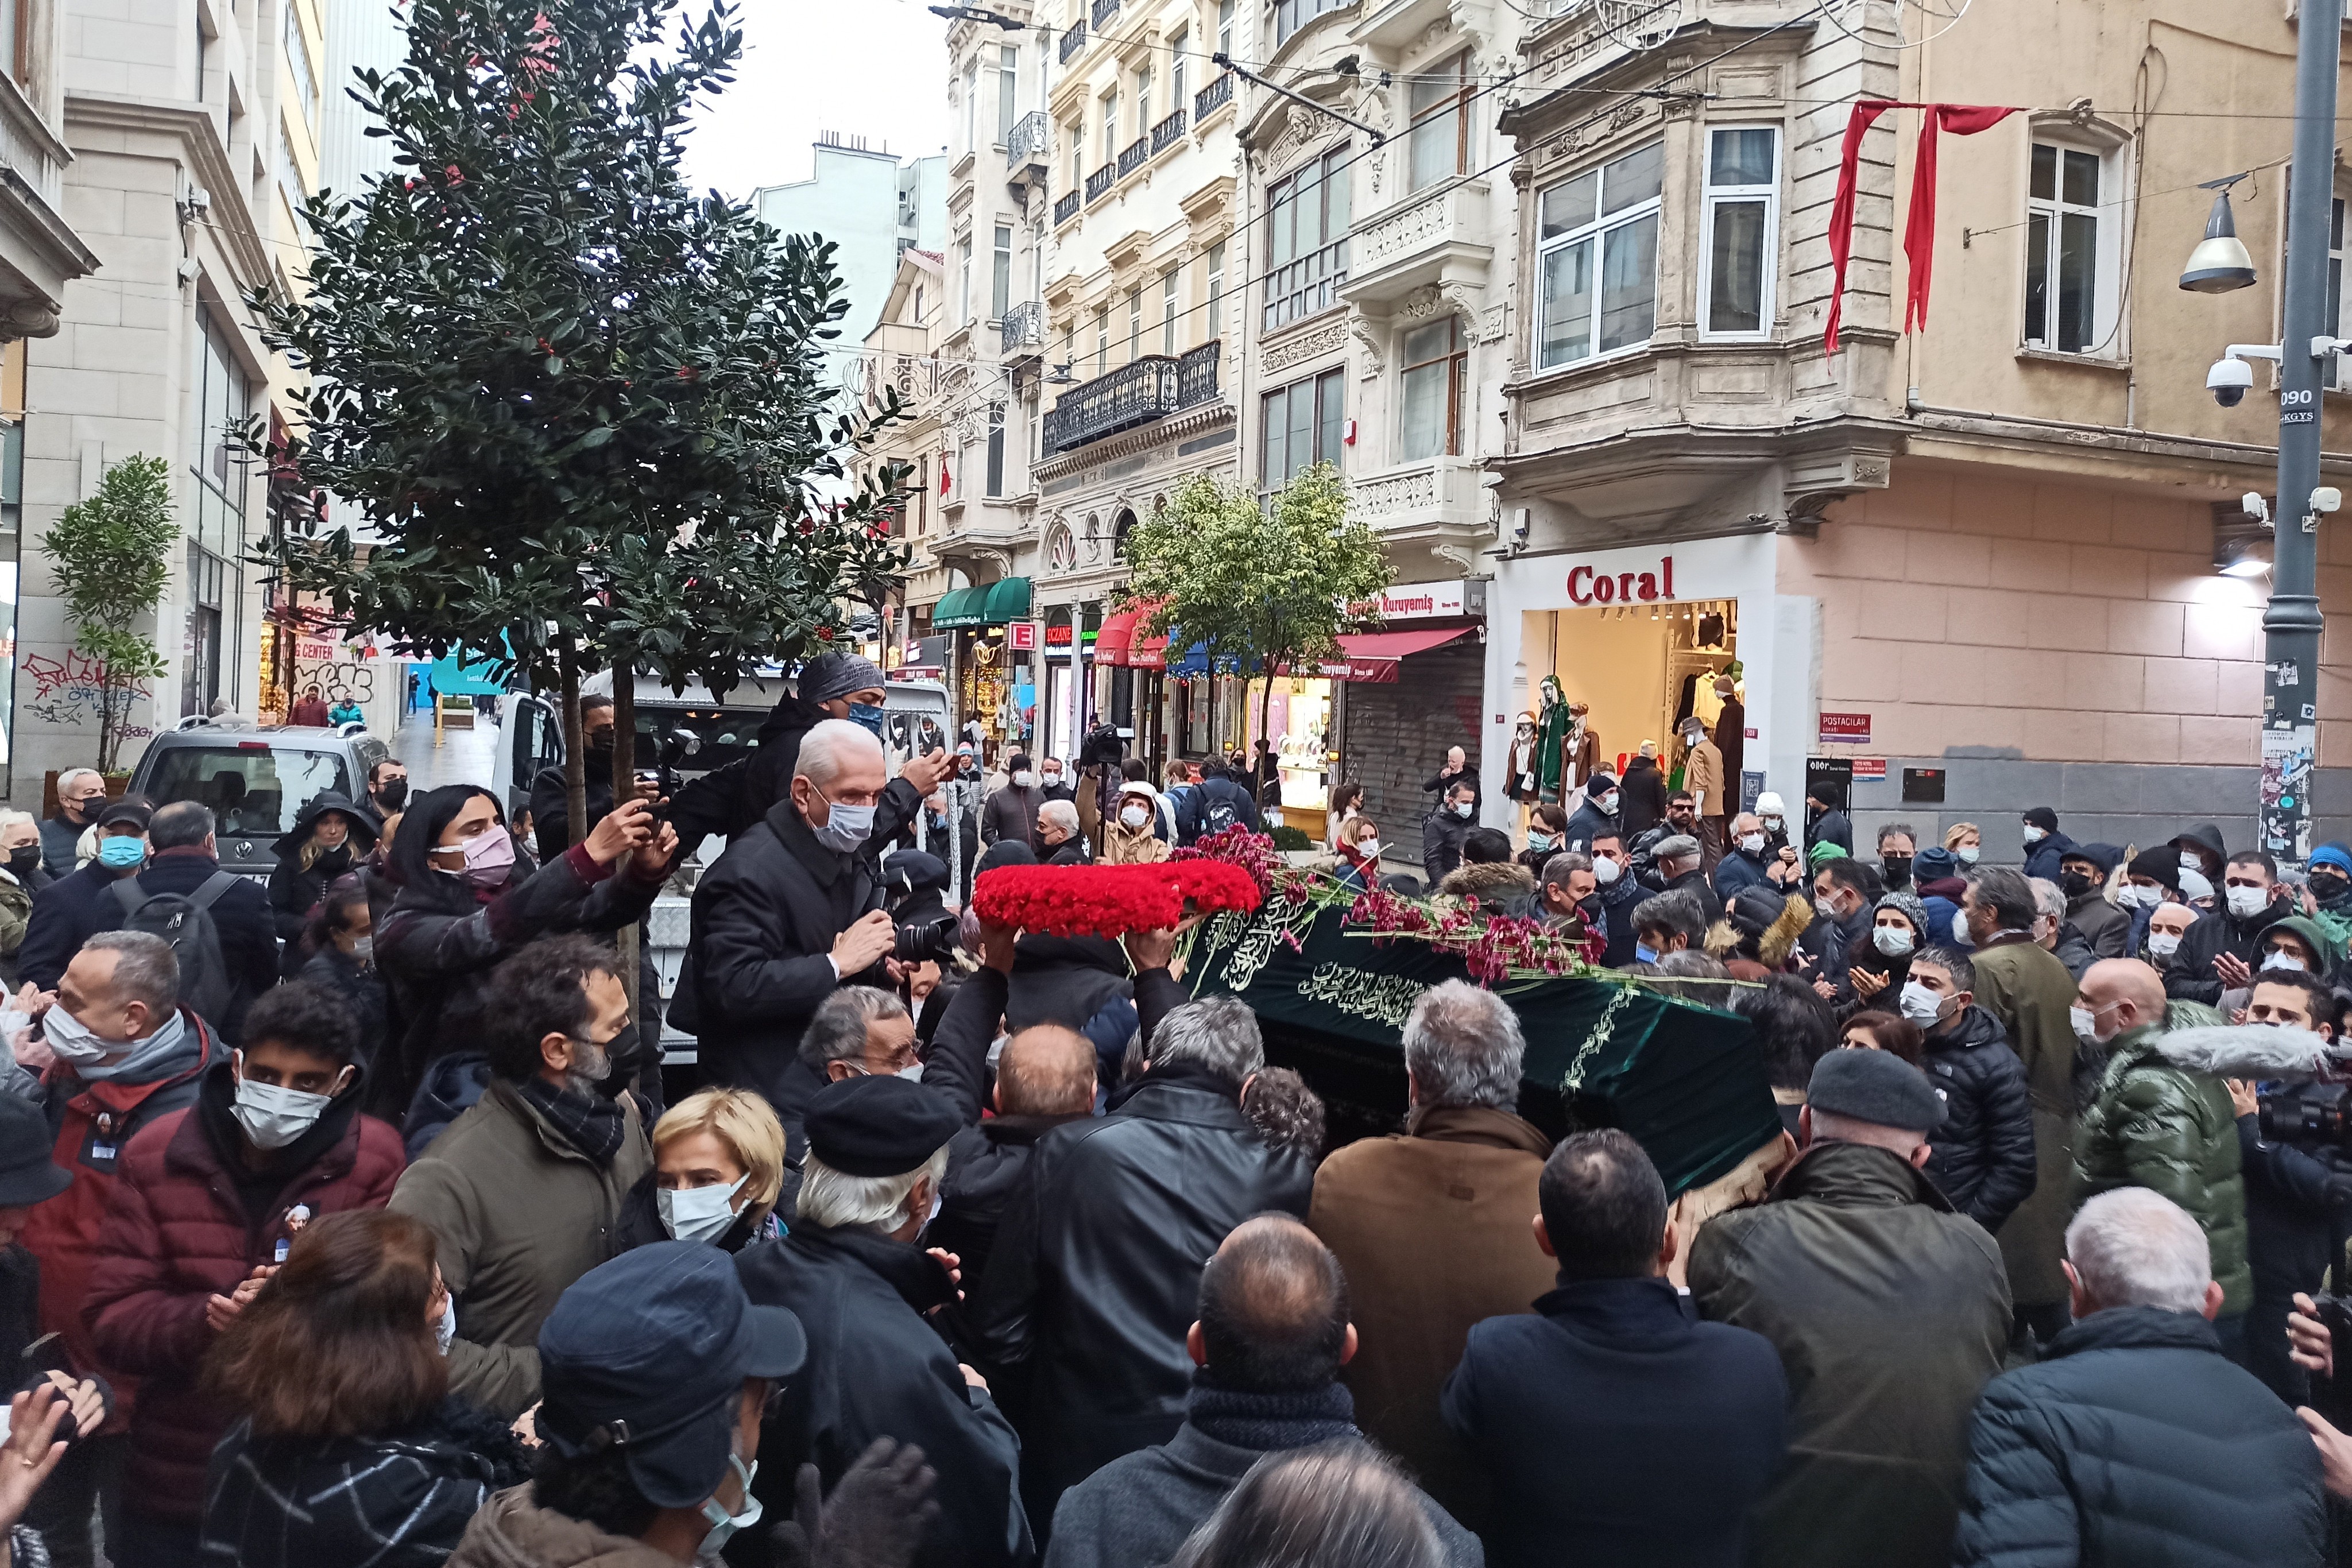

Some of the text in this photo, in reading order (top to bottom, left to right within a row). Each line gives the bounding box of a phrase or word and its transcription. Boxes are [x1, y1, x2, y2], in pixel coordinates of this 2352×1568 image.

[2281, 390, 2312, 405] 090
[2284, 412, 2314, 420] KGYS
[1567, 556, 1674, 603] Coral
[1382, 594, 1433, 614] Kuruyemiş
[1047, 626, 1071, 642] ECZANE
[303, 644, 333, 660] CENTER
[1823, 716, 1866, 726] POSTACILAR
